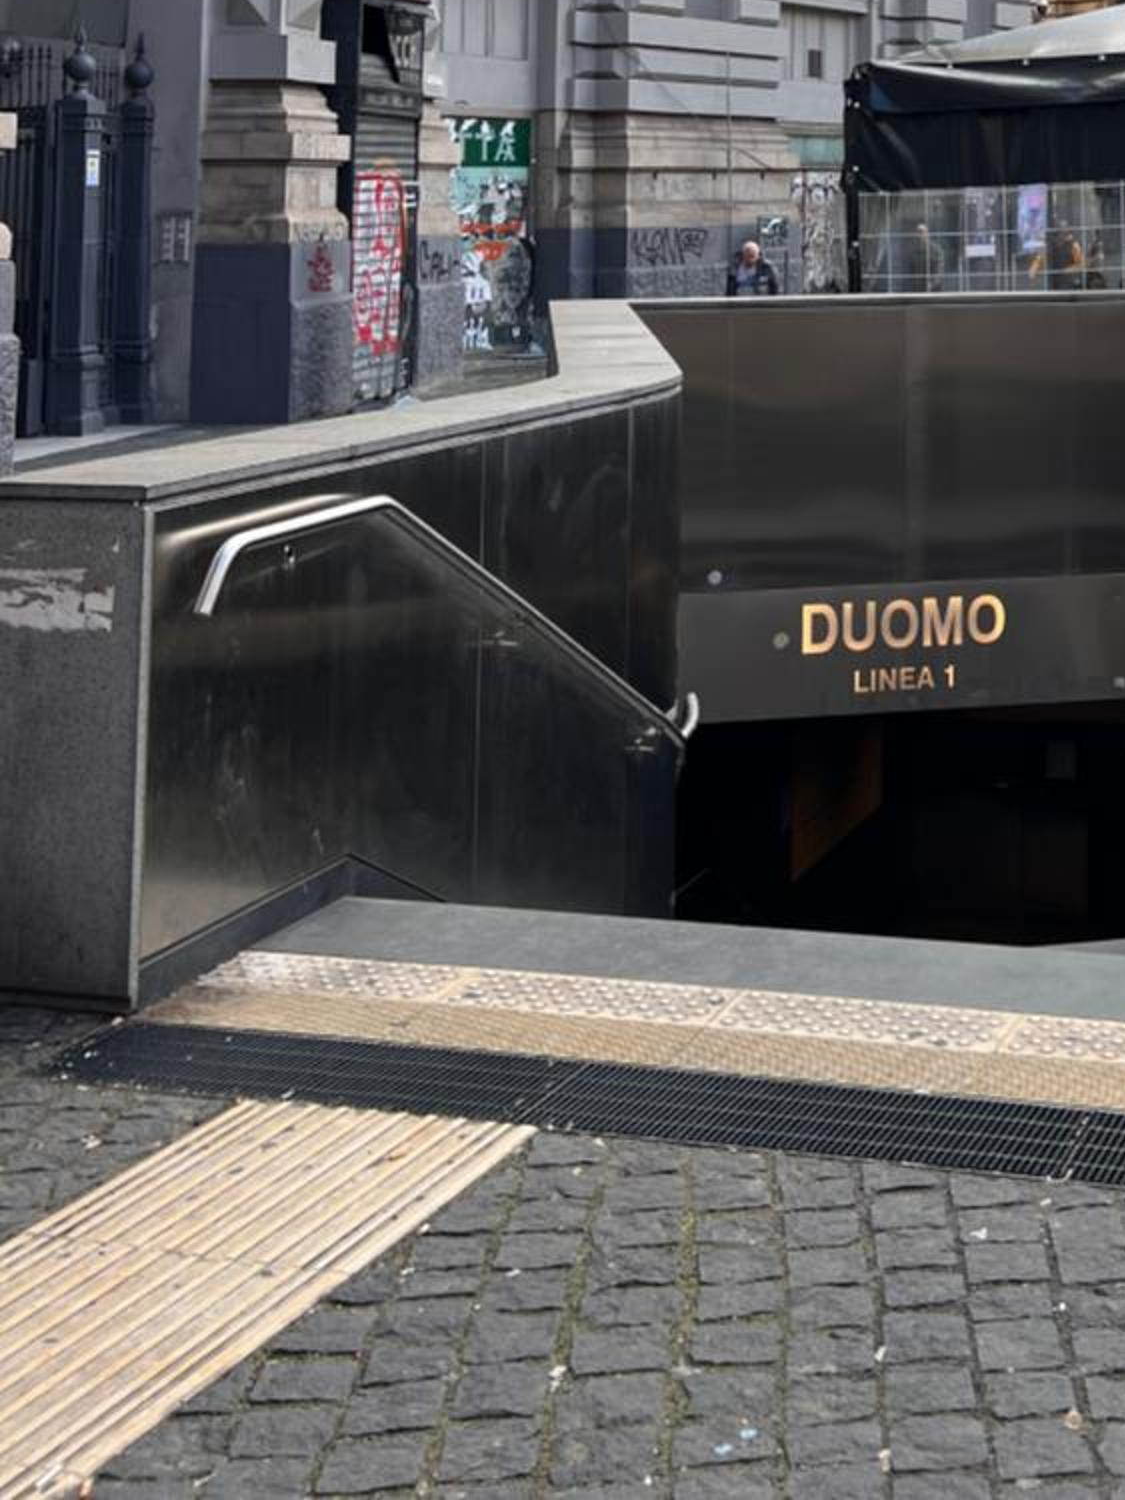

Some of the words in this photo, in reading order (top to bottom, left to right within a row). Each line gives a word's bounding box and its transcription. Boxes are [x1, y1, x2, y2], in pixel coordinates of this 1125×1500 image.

[801, 593, 1006, 655] DUOMO
[853, 665, 935, 693] LINEA
[944, 663, 957, 689] 1
